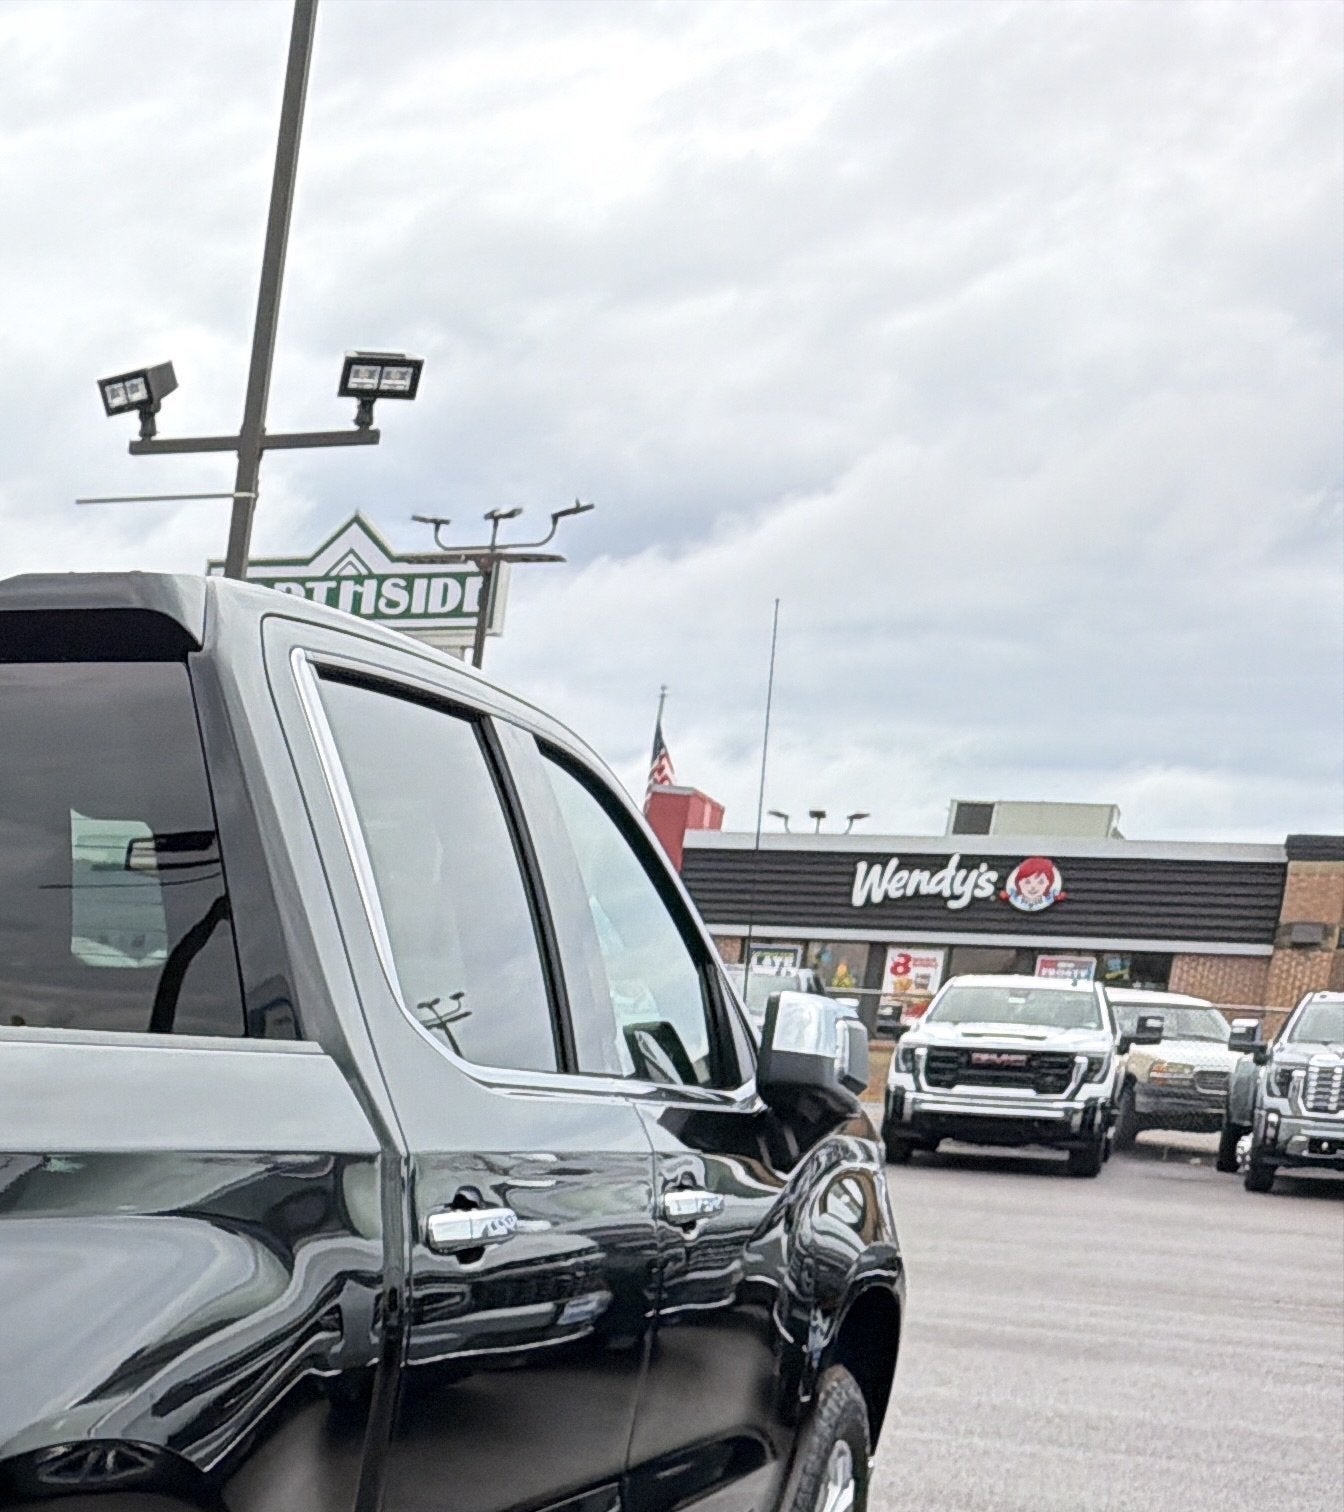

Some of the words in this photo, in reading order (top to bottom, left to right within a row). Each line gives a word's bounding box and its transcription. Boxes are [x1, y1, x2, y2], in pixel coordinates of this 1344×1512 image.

[273, 576, 484, 616] THSIDE
[851, 852, 999, 910] Wendy's
[971, 1052, 1028, 1068] GMC
